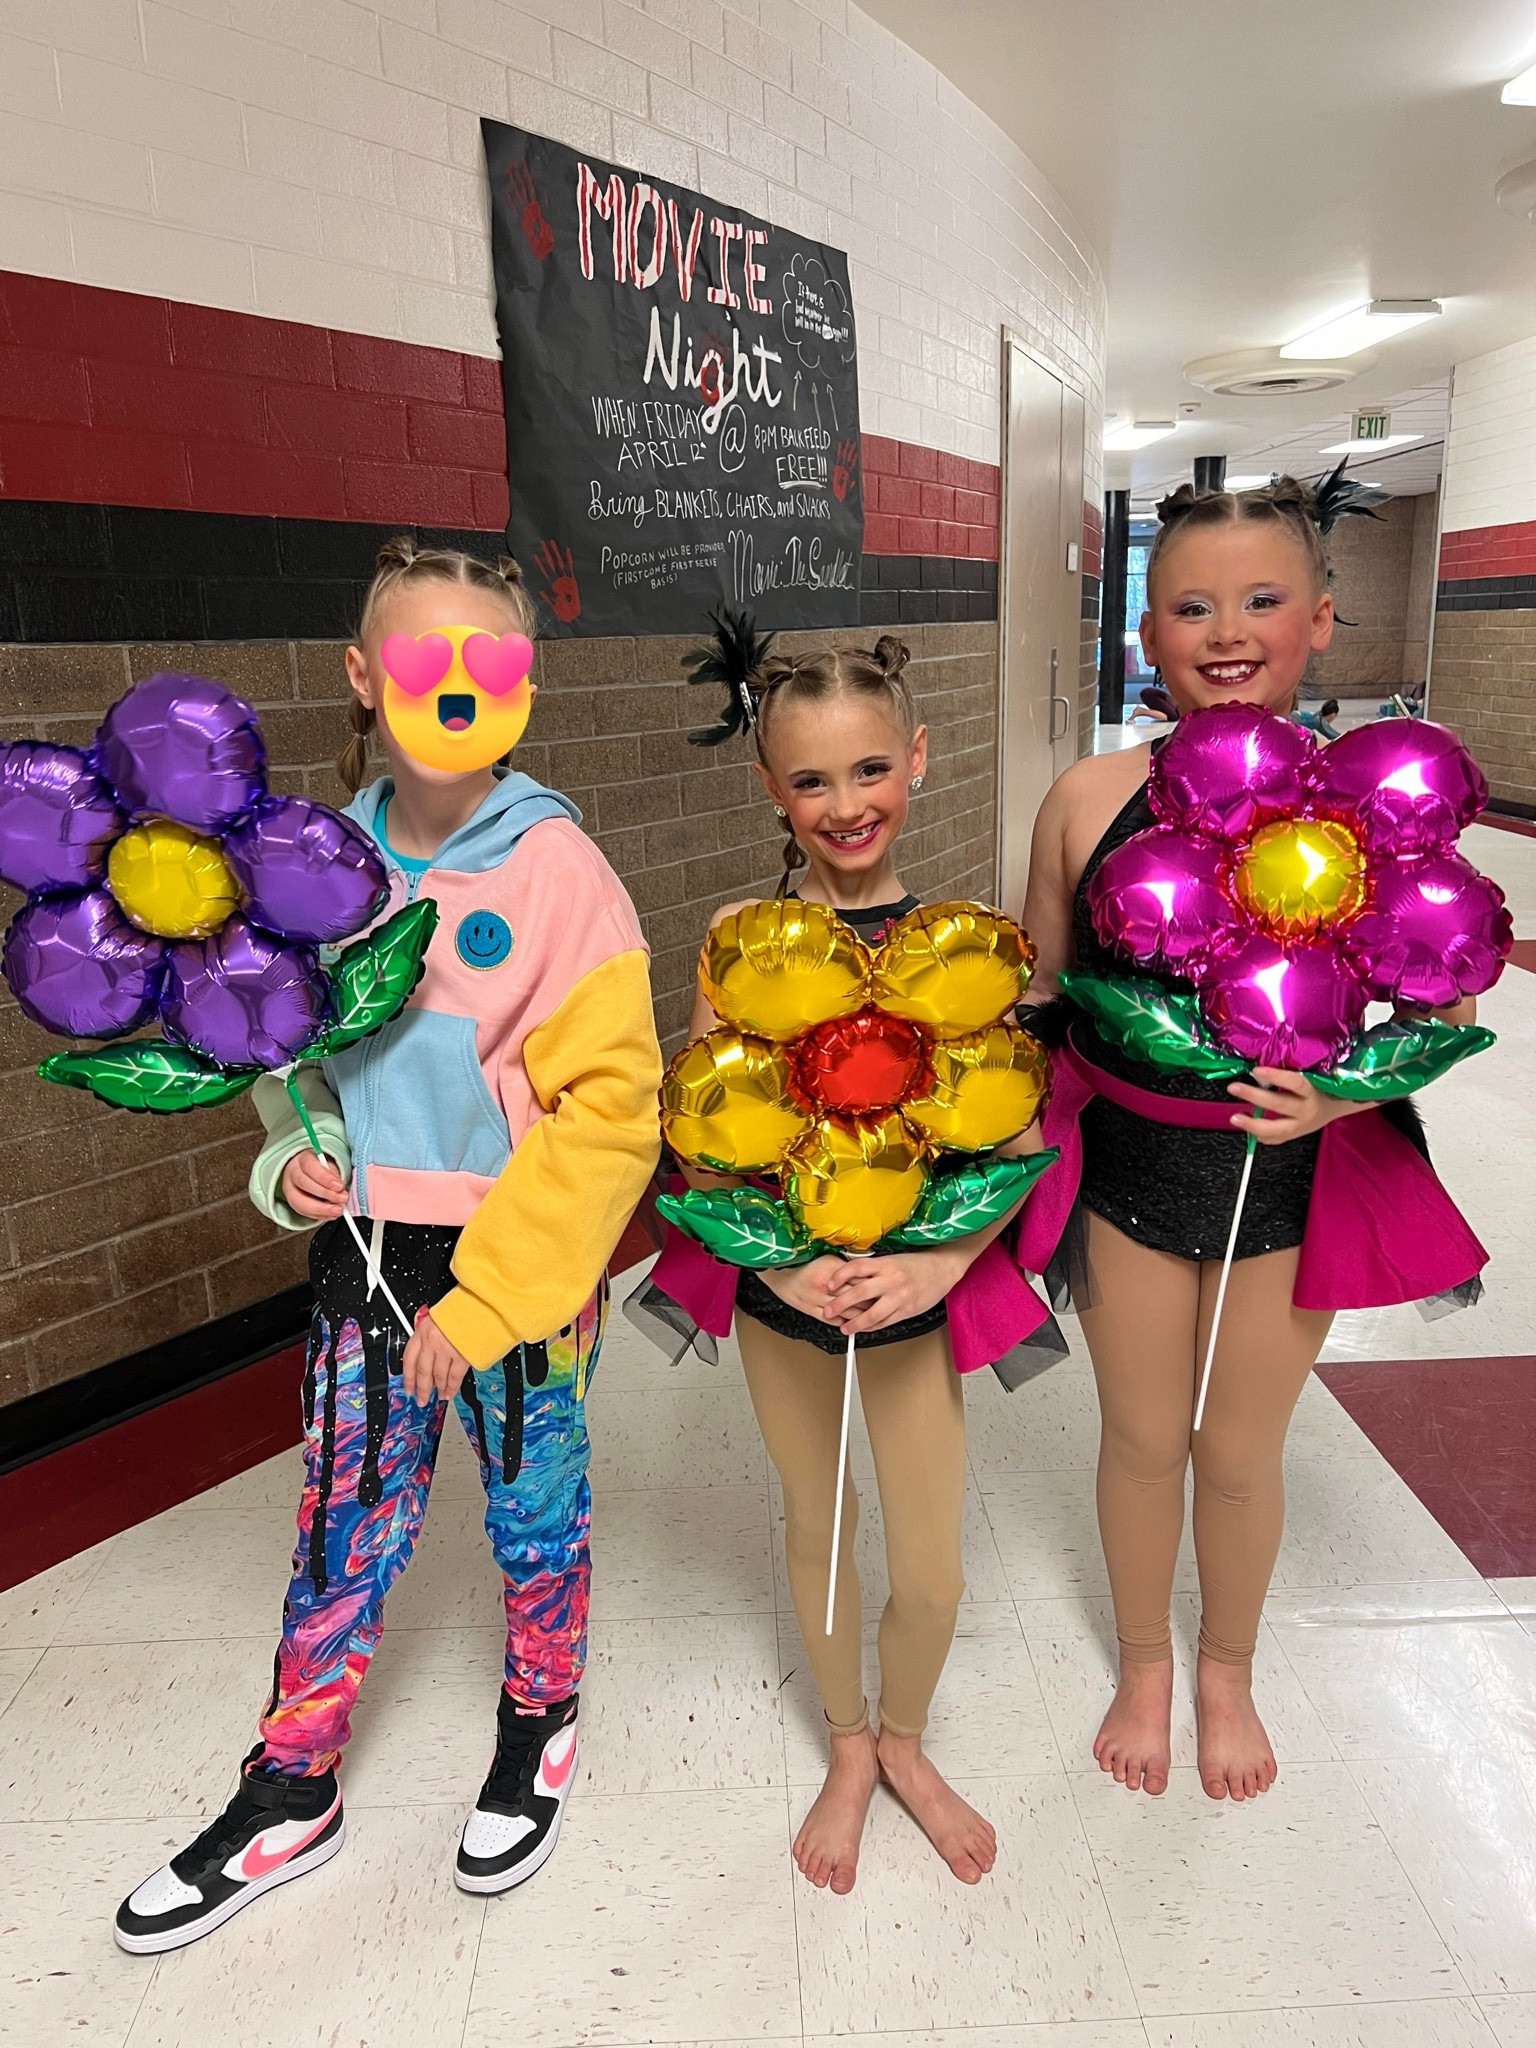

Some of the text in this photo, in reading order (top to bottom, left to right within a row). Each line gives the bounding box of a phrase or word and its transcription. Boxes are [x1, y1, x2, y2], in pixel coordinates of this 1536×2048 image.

[577, 162, 773, 315] MOVIE
[643, 305, 782, 434] Night
[592, 396, 704, 440] WHEN: FRIDAY
[719, 404, 747, 473] @
[1357, 416, 1387, 439] EXIT
[618, 441, 688, 471] APRIL
[776, 453, 827, 483] FREE!!!
[588, 480, 654, 528] Bring
[727, 492, 776, 519] CHAIRS,
[777, 494, 794, 518] and
[796, 493, 830, 520] SNACKS
[658, 546, 679, 560] WILL
[680, 545, 691, 556] BE
